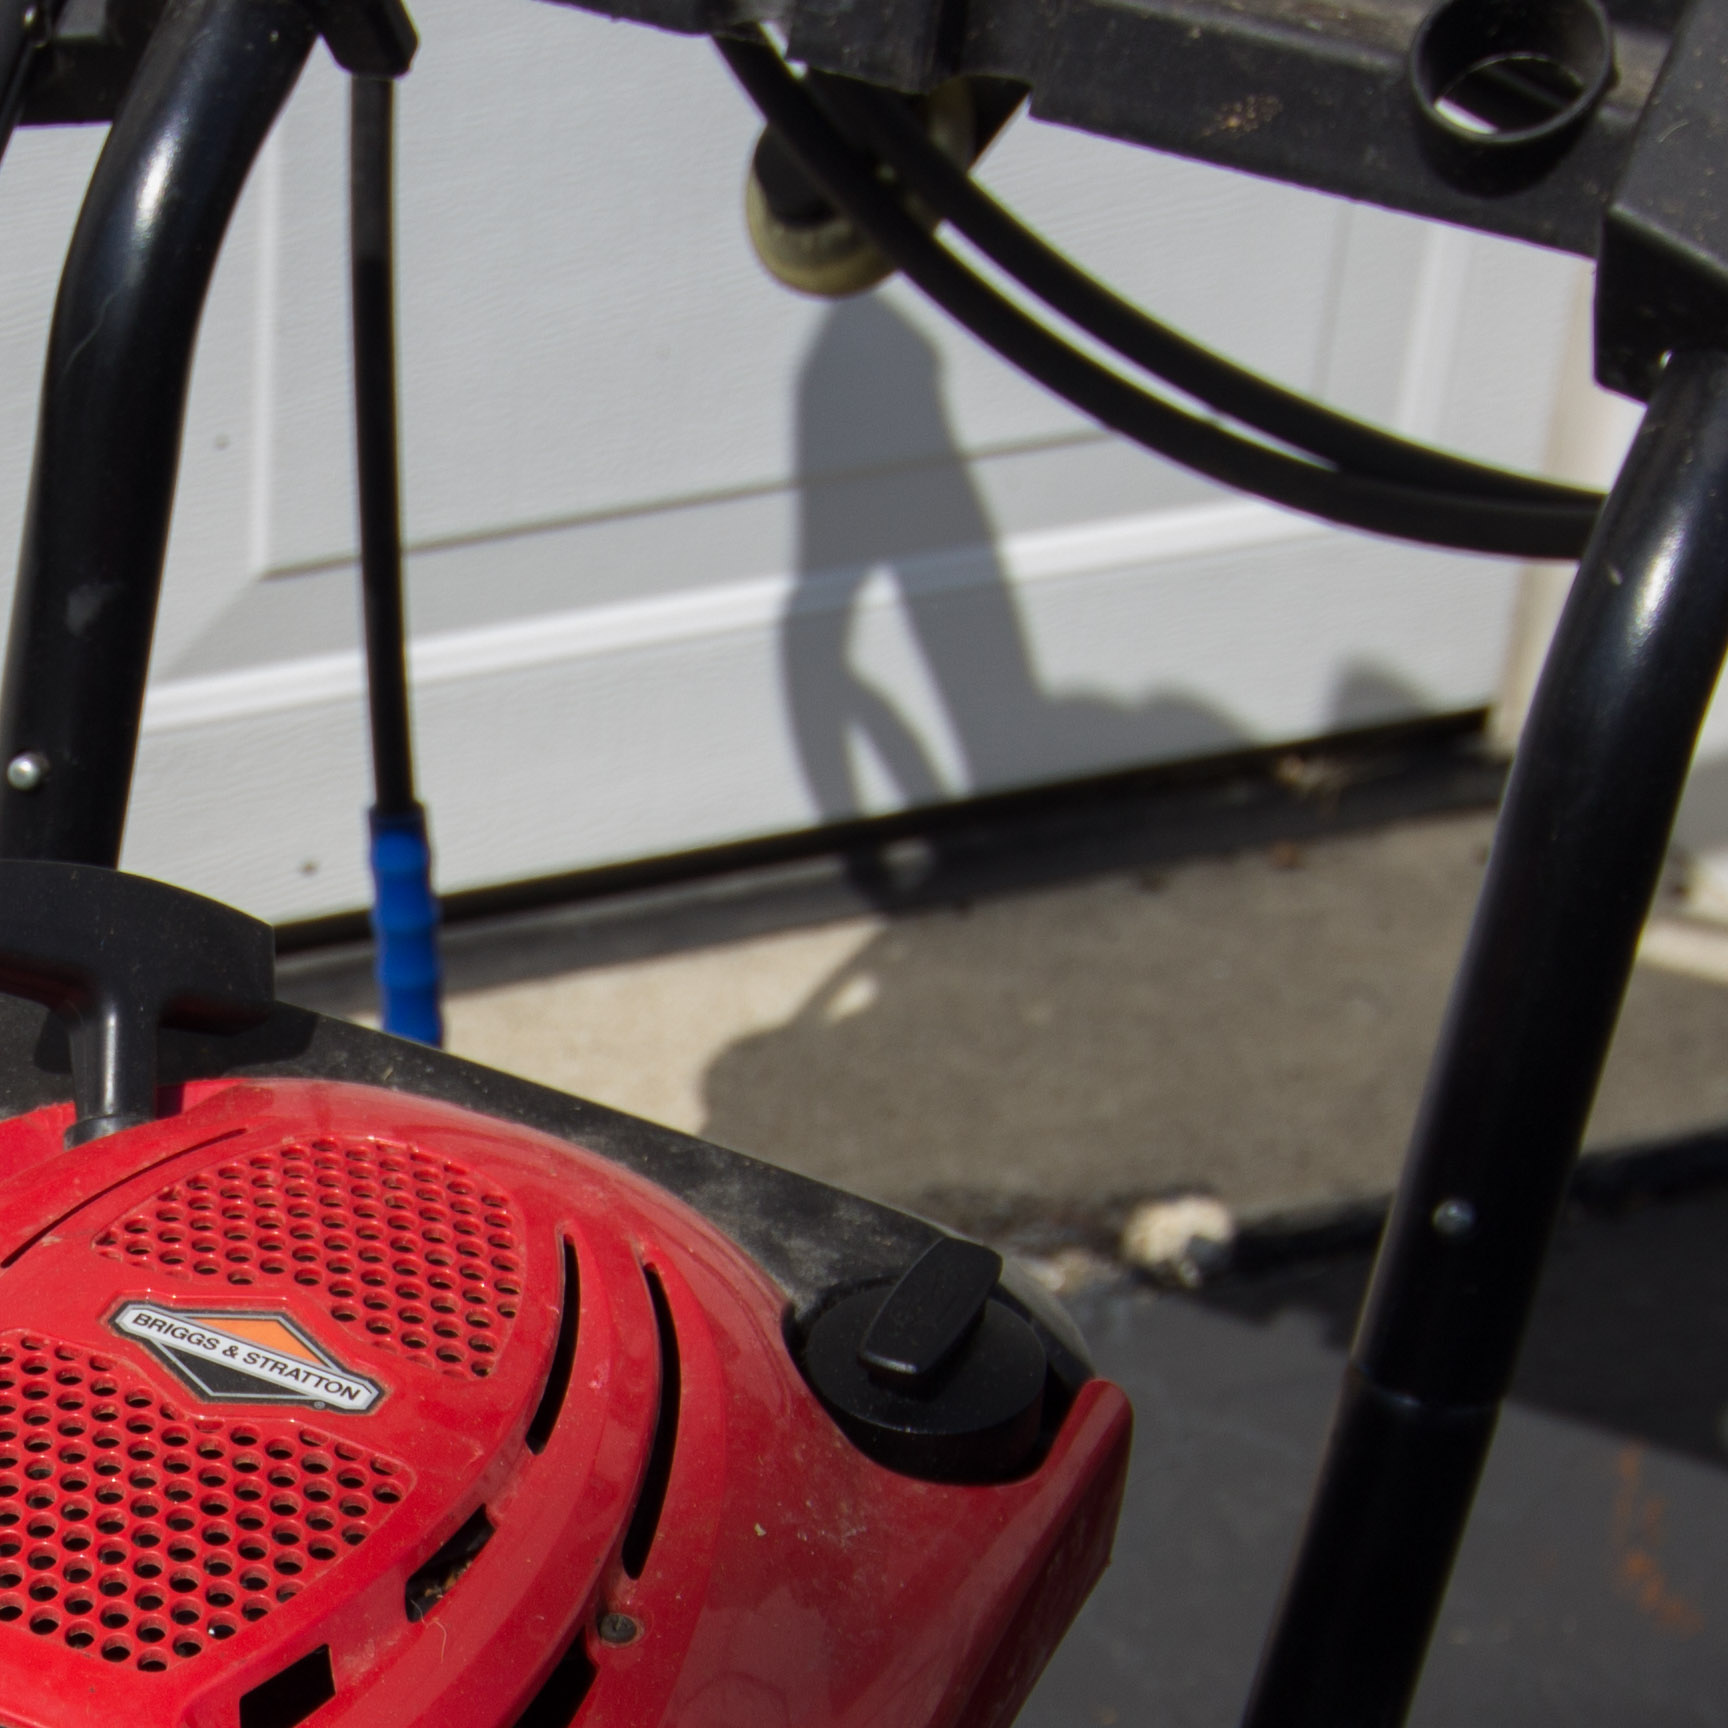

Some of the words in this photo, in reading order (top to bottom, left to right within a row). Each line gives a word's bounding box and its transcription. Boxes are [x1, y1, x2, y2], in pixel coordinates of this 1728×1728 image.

[131, 1312, 222, 1351] BRIGGS
[222, 1345, 240, 1360] &
[242, 1351, 362, 1401] STRATTON
